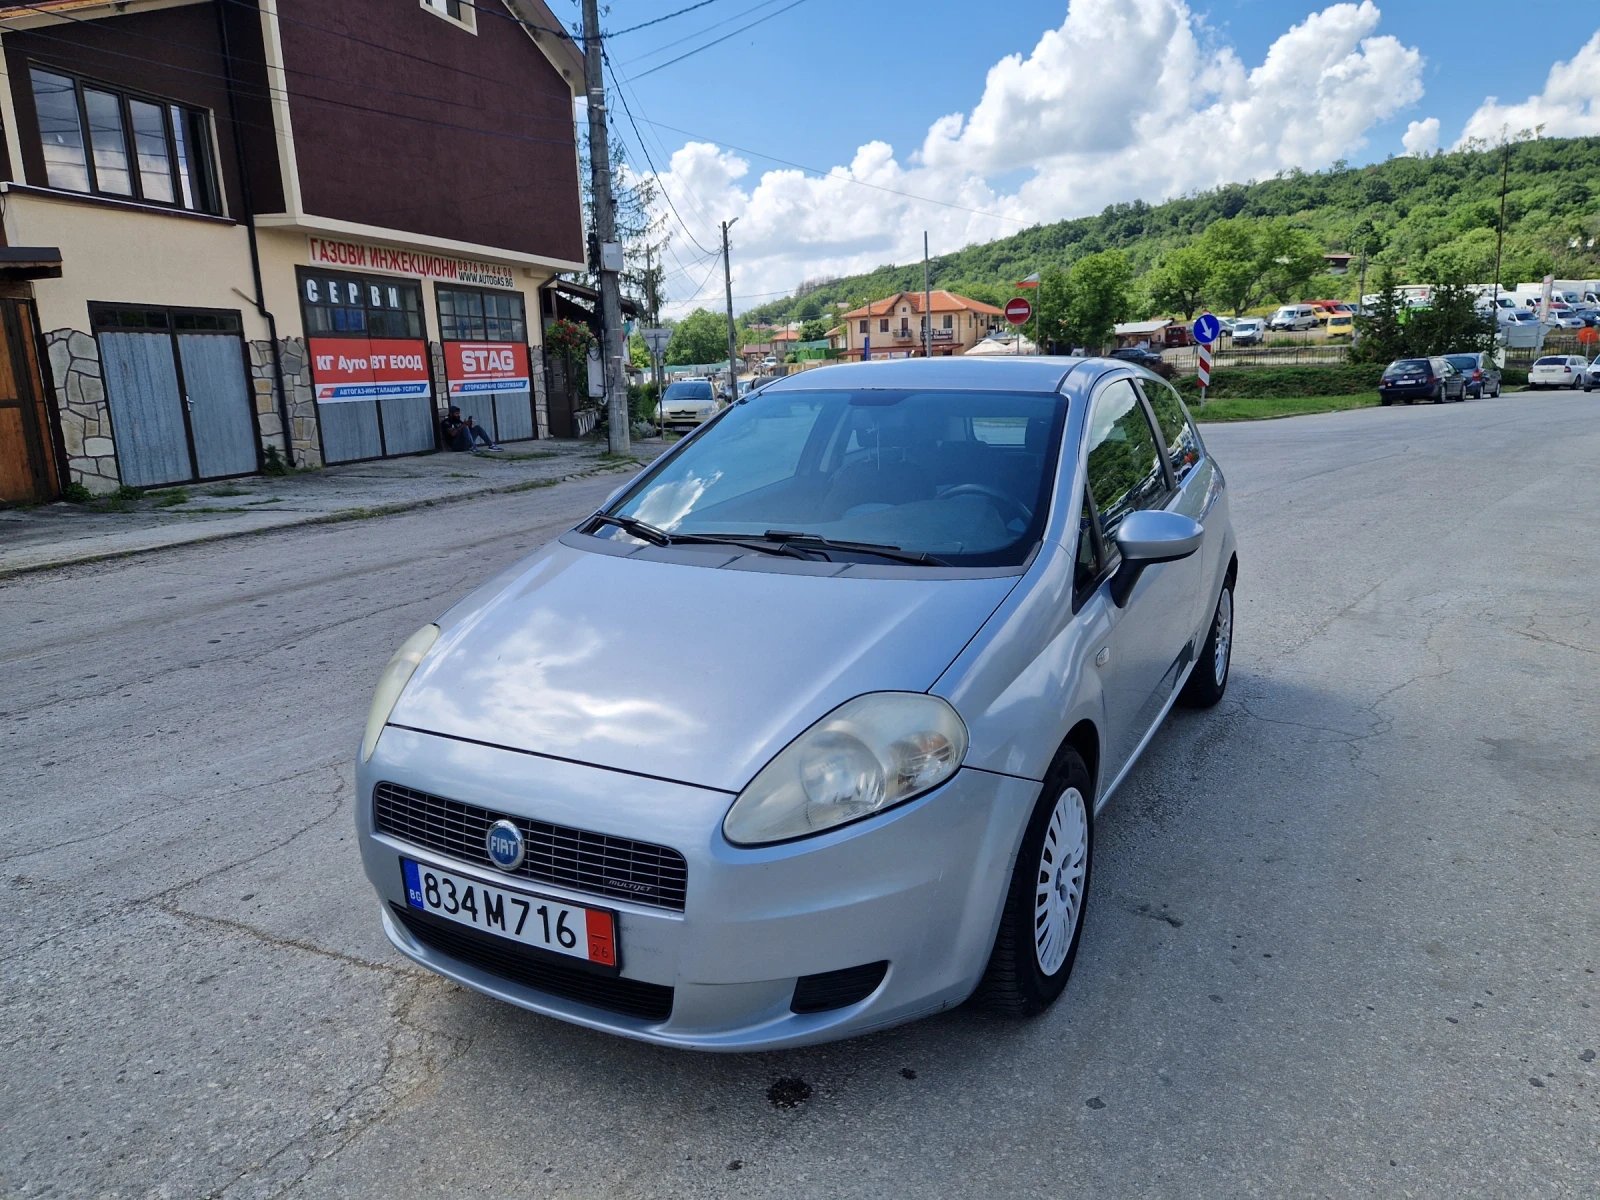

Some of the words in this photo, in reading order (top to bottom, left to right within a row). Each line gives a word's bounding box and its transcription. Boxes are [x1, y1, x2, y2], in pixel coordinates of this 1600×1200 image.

[310, 238, 366, 267] ГАЗОВИ
[369, 246, 457, 279] ИНЖЕКЦИОНИ
[458, 260, 478, 273] 0876
[480, 263, 489, 274] 99
[492, 265, 501, 276] 44
[458, 271, 514, 288] WWW.AUTOGAS.BG
[316, 355, 334, 371] КГ
[338, 355, 367, 373] Ауто
[370, 355, 386, 369] ВТ
[389, 355, 423, 371] ЕООД
[461, 350, 514, 372] STAG
[491, 835, 516, 856] FIAT
[409, 888, 421, 902] BG
[592, 943, 609, 958] 26
